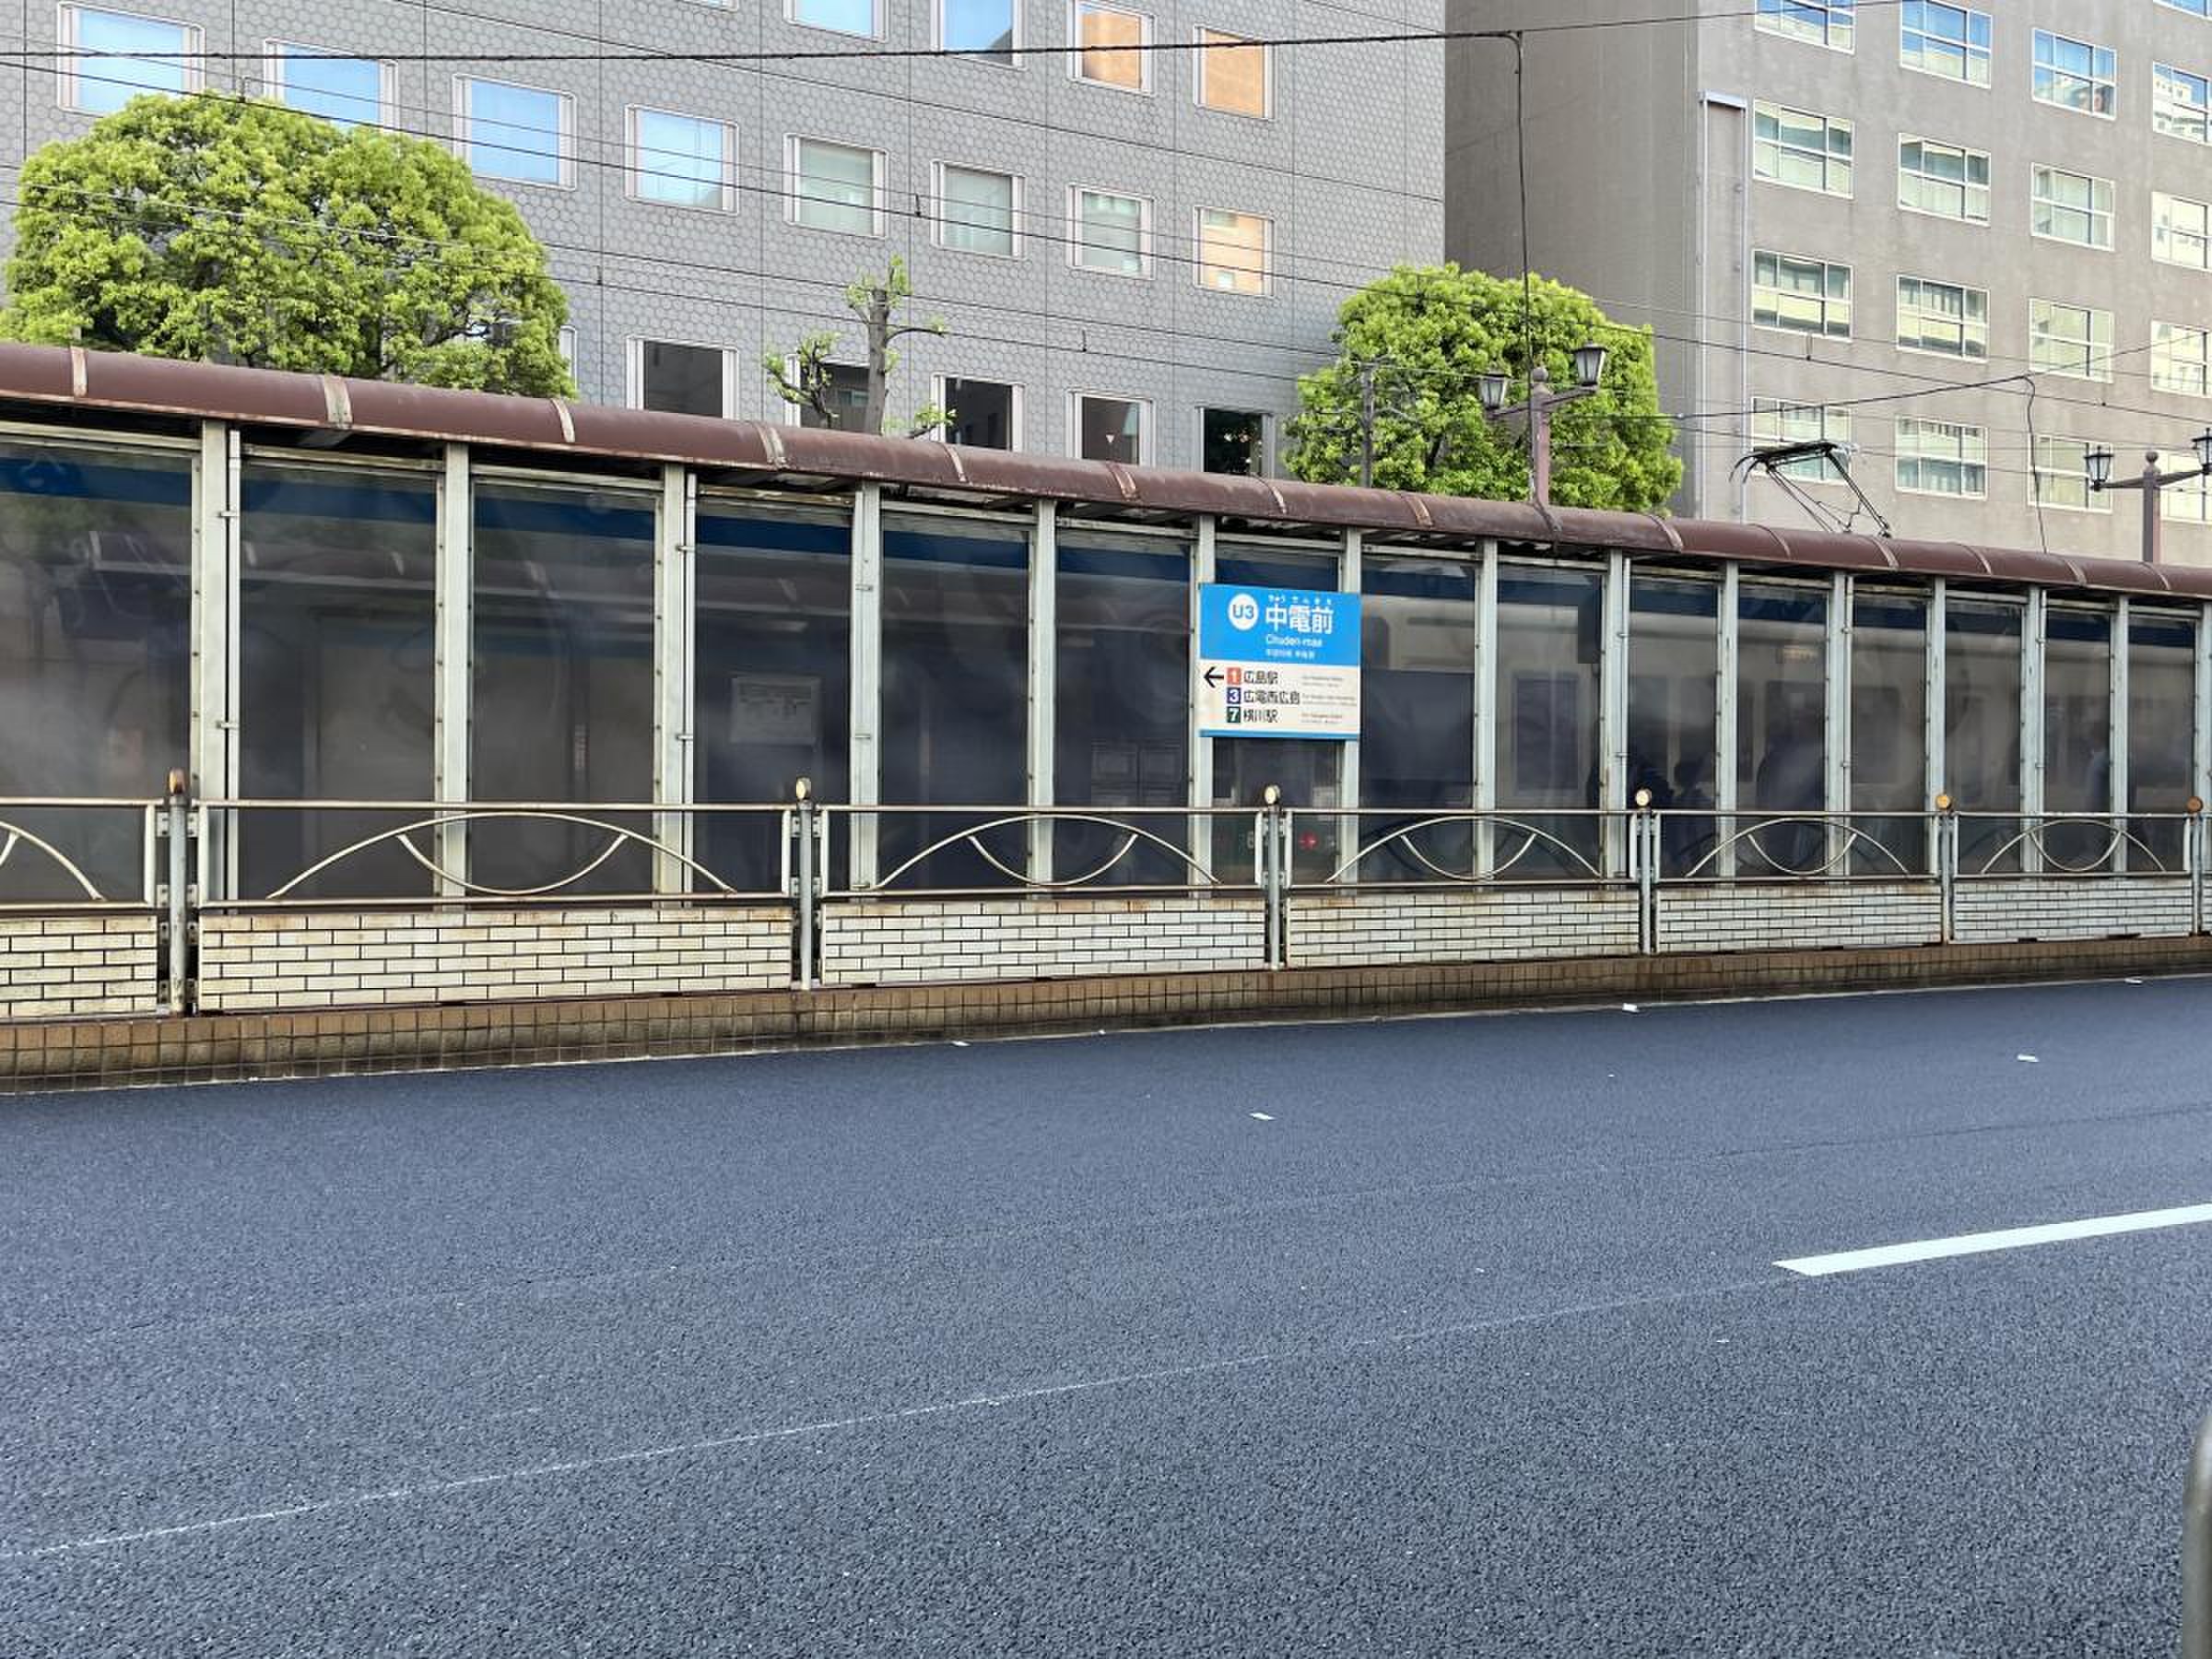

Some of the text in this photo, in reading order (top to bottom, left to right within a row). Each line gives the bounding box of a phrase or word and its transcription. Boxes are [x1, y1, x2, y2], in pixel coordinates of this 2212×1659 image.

[1232, 604, 1334, 634] U3 中電前
